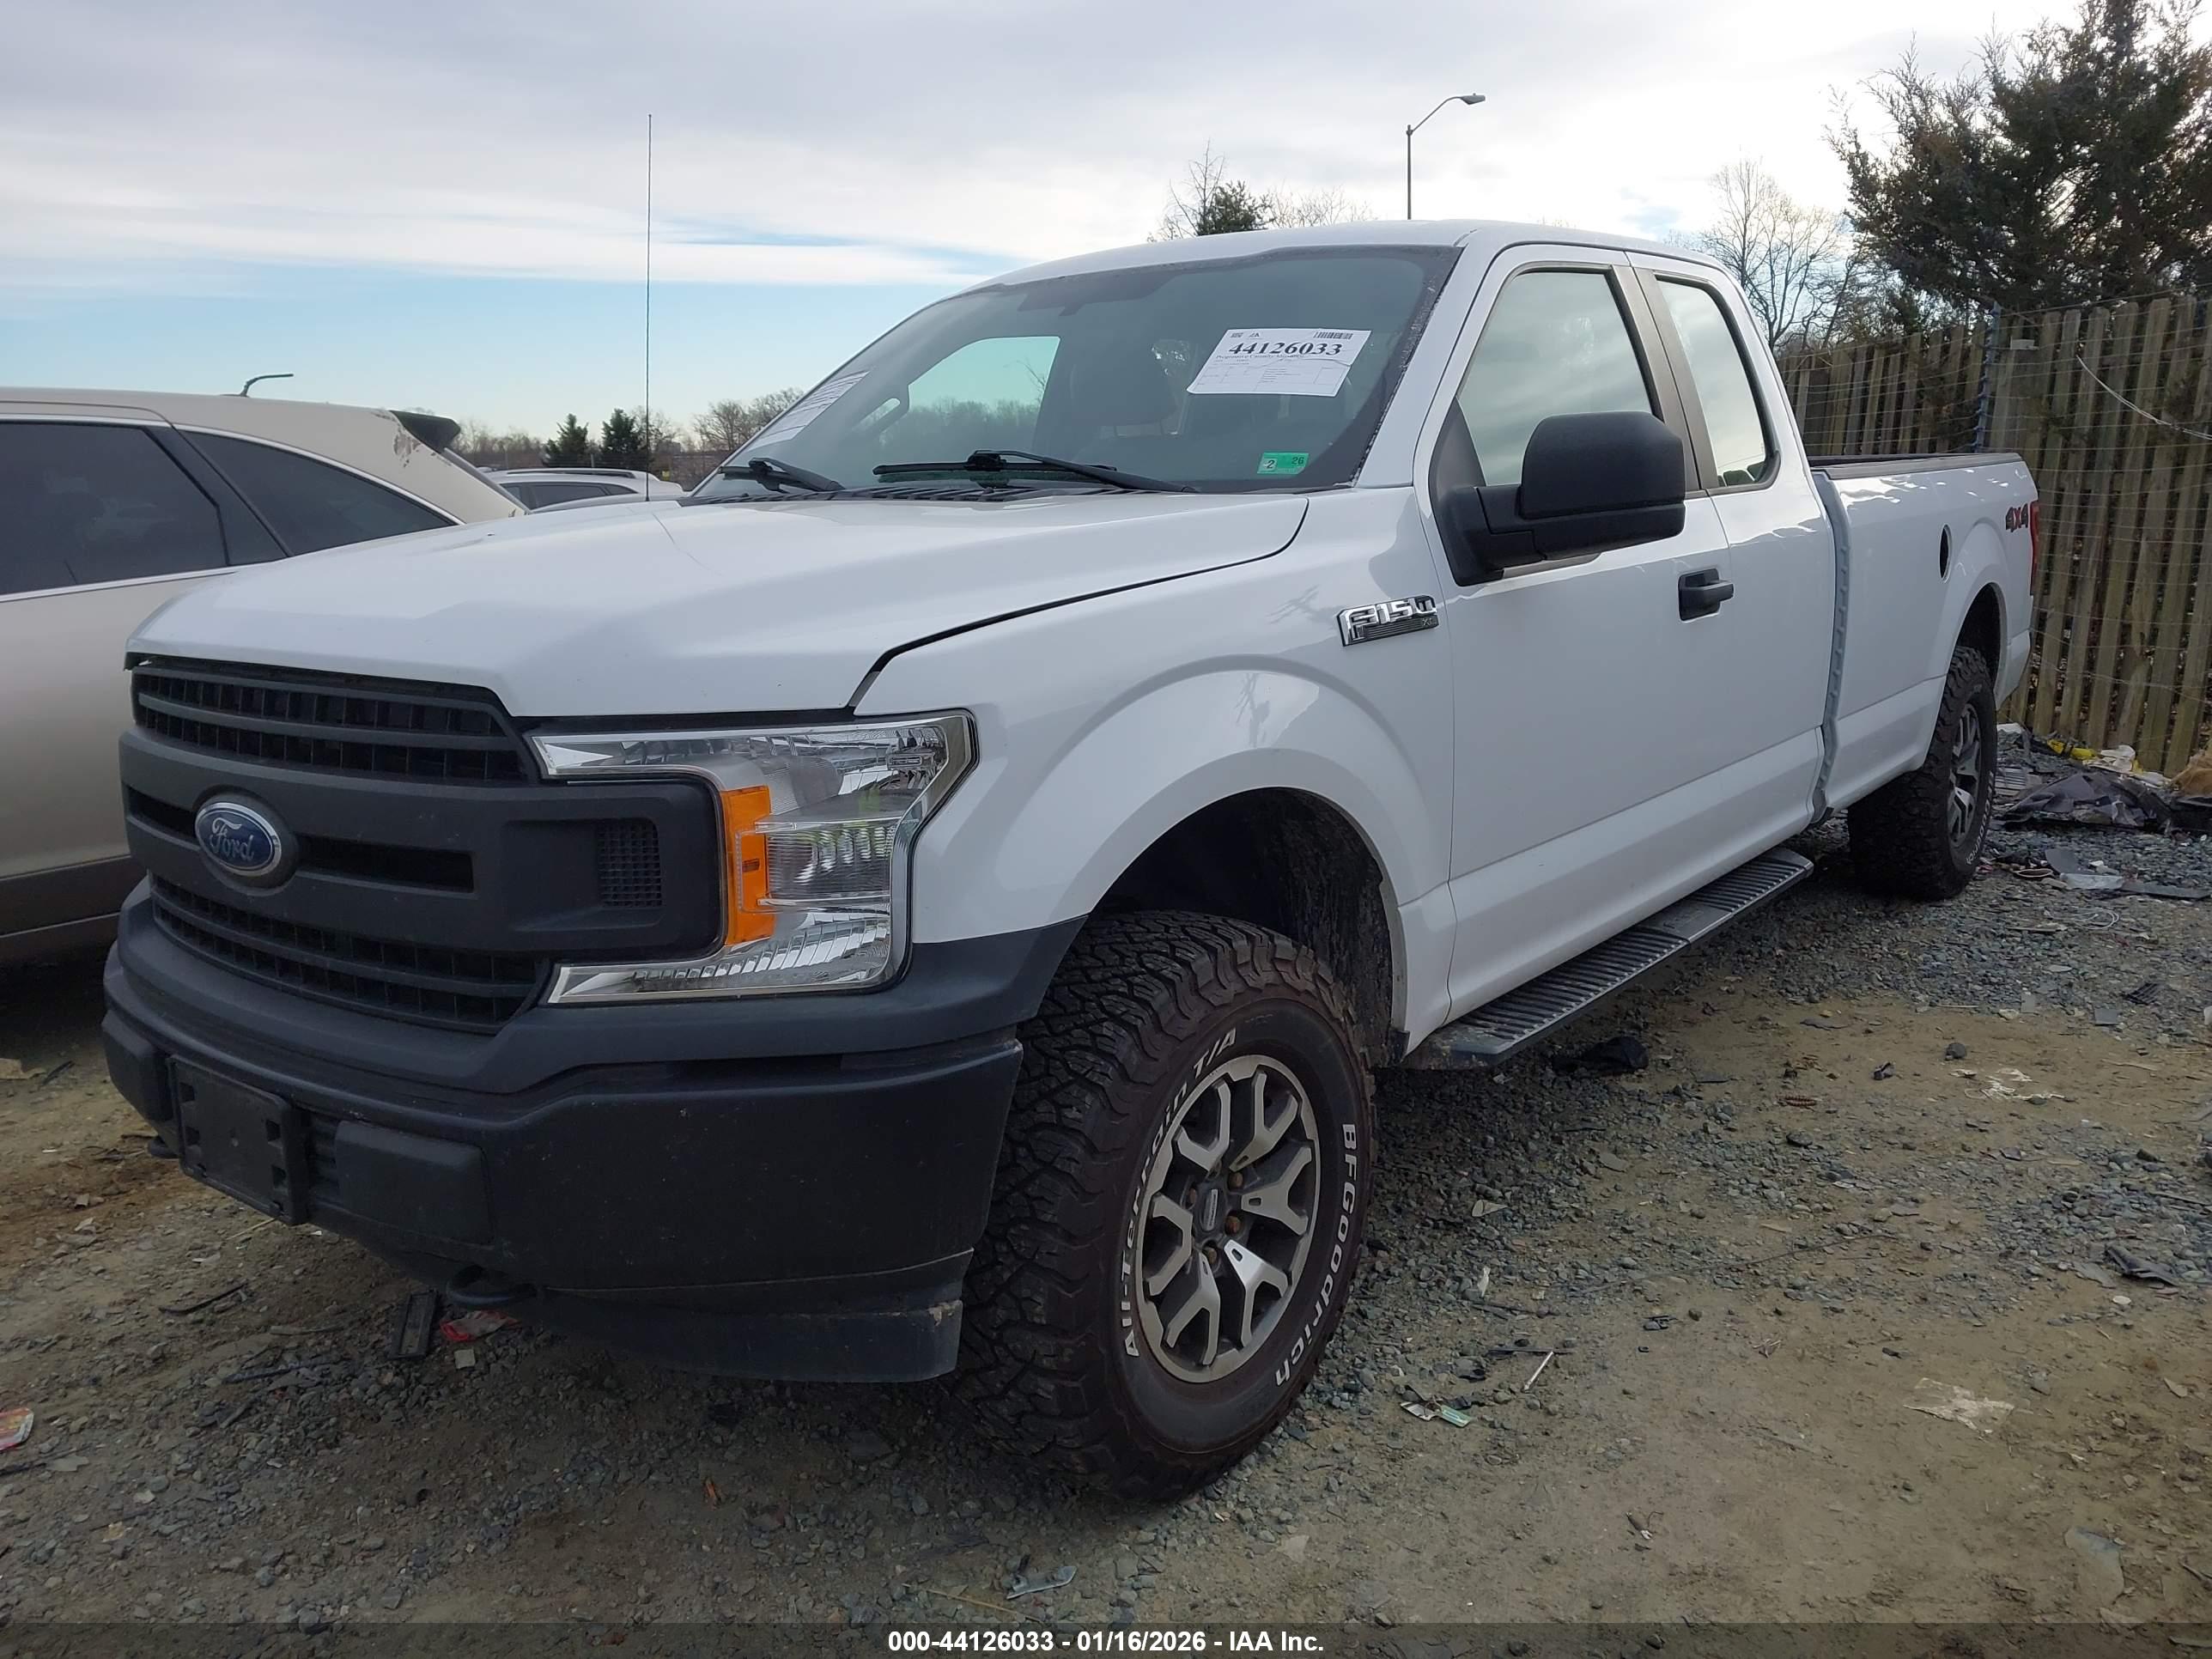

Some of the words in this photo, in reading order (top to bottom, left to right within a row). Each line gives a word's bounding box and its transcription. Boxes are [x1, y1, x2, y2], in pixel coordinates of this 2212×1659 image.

[1228, 342, 1343, 356] 44126033
[1267, 459, 1275, 469] 2
[1291, 456, 1304, 465] 26
[209, 817, 255, 862] Ford
[1119, 1083, 1188, 1358] All-Terrain
[1191, 1027, 1237, 1078] T/A
[1274, 1122, 1358, 1389] BFGoodrich
